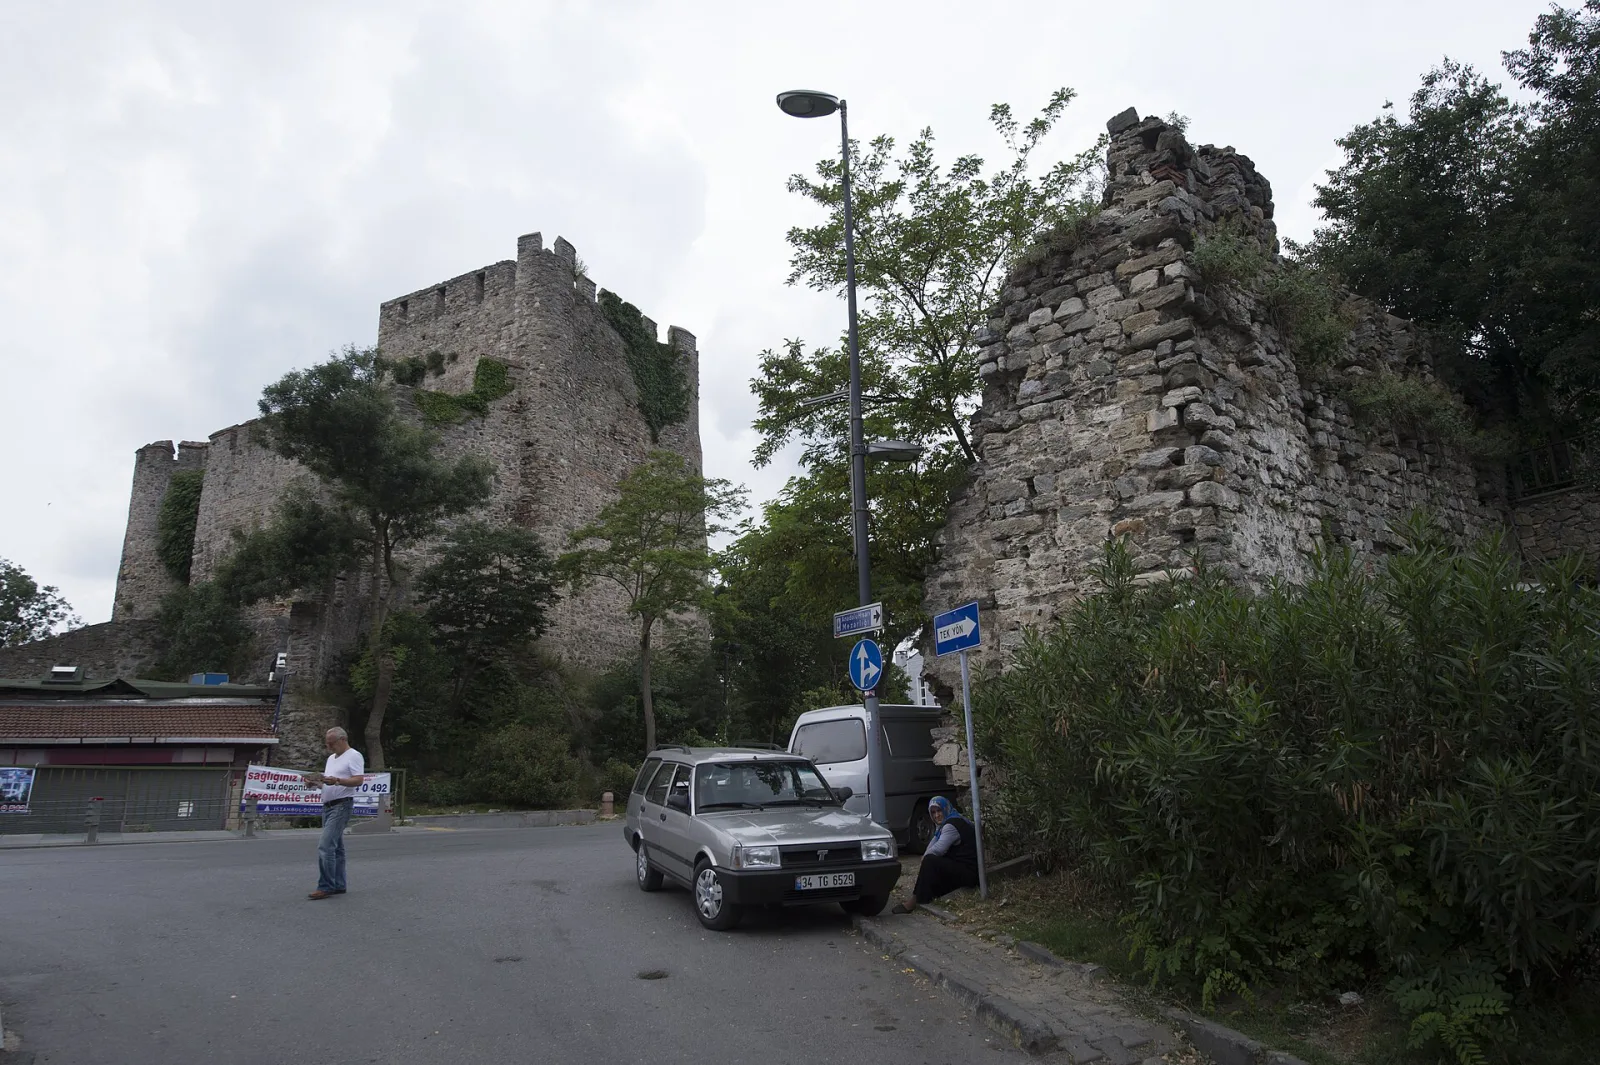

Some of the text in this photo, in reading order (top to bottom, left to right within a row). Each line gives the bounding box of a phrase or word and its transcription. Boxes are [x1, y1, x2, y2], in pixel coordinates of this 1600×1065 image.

[940, 624, 964, 639] TEK YÖN
[247, 771, 298, 783] sağlığınız
[370, 783, 388, 793] 492
[802, 873, 854, 888] 34 TG 6529
